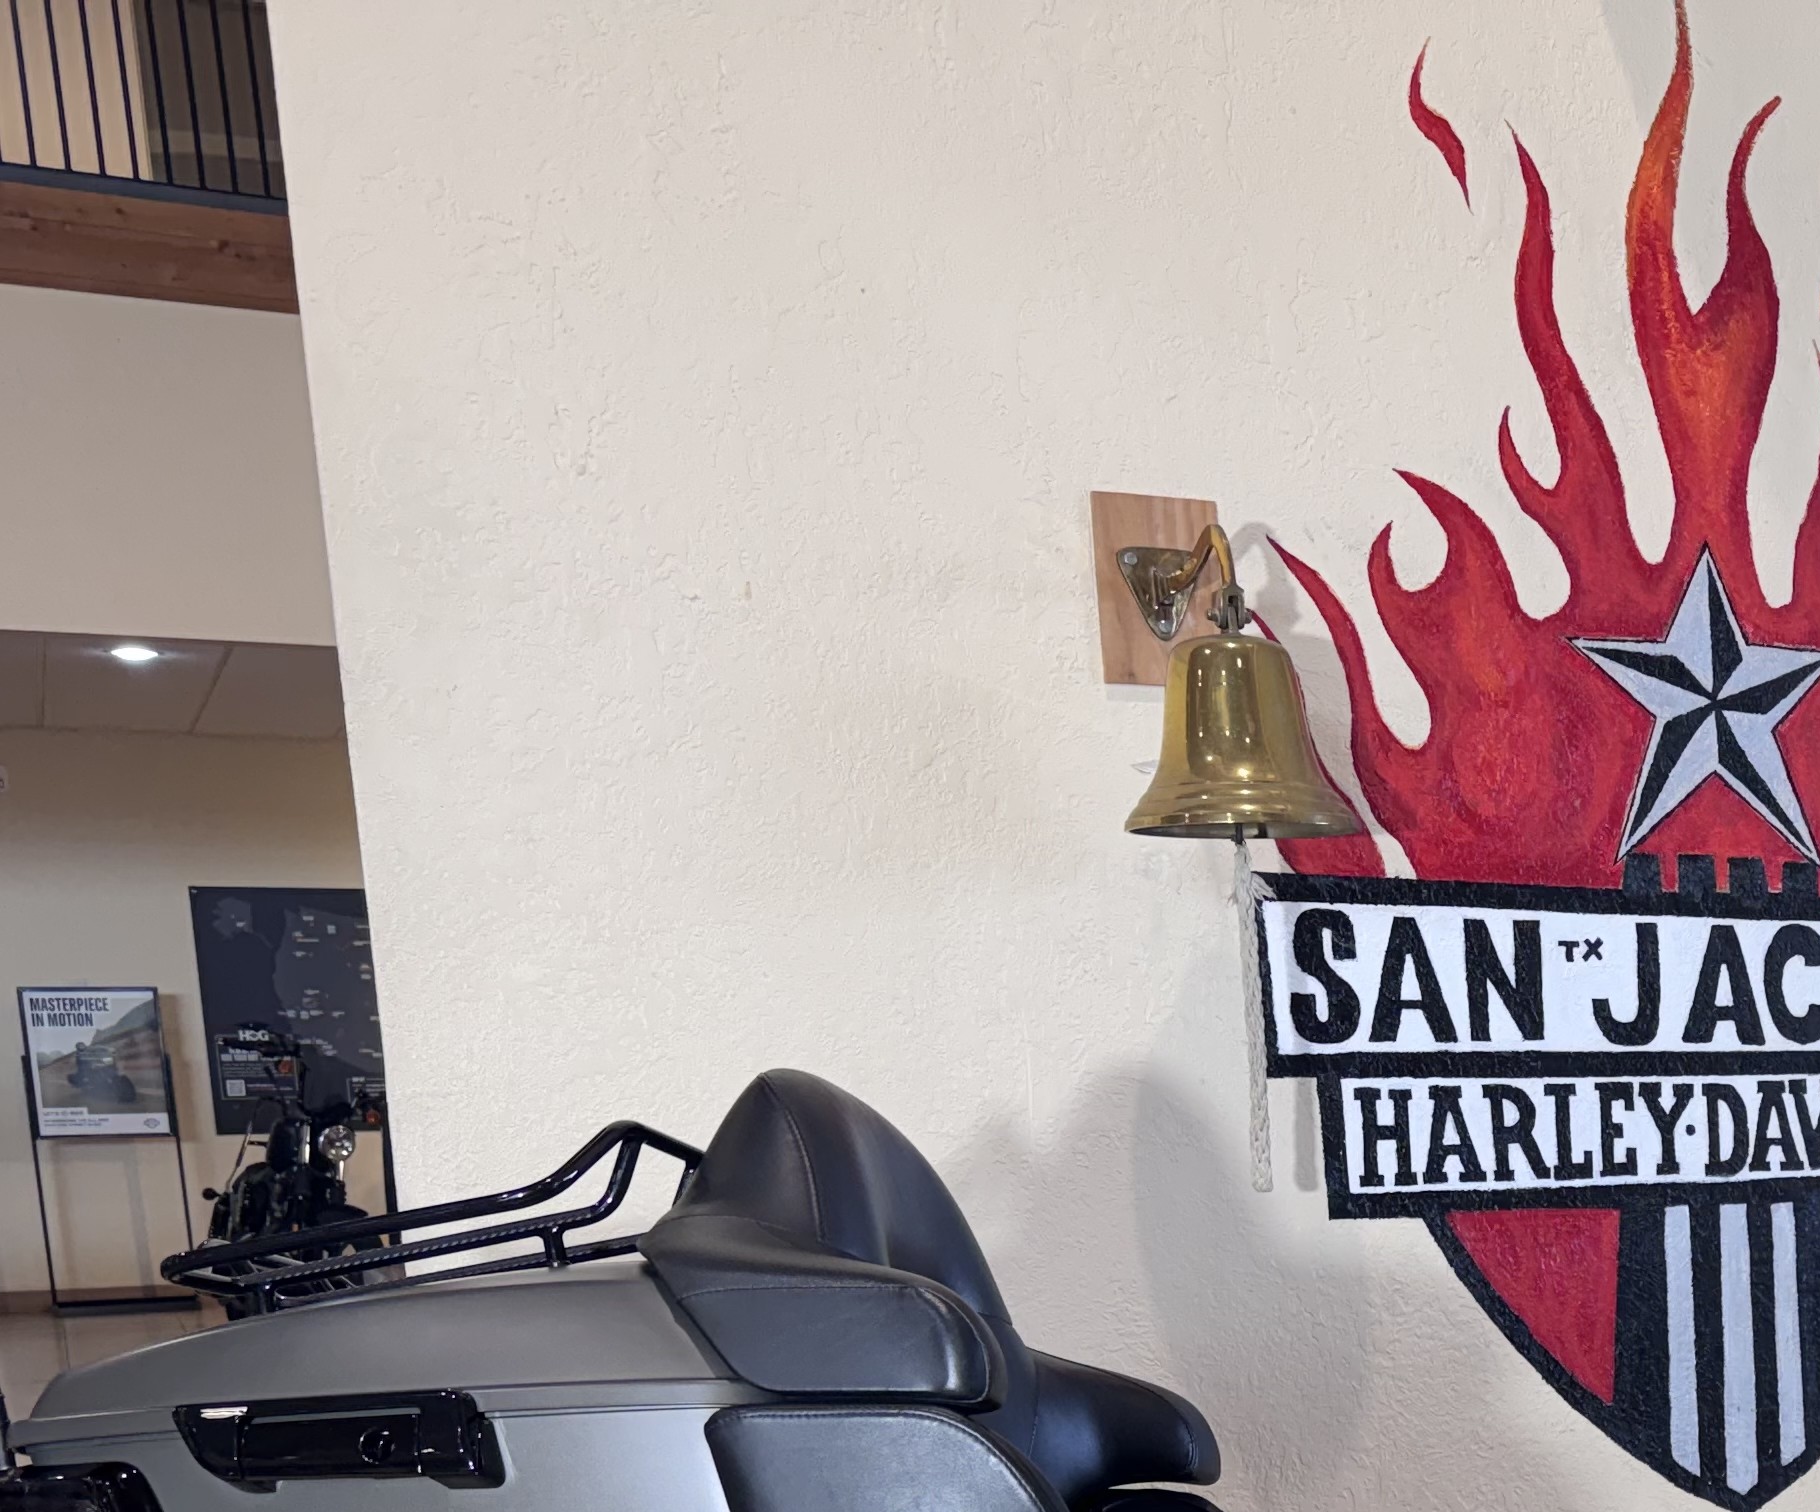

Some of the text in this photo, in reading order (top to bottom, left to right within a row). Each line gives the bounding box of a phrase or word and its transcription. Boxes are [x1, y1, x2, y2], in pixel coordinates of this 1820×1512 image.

[1290, 907, 1545, 1046] SAN
[1559, 937, 1604, 963] TX
[29, 997, 109, 1012] MASTERPIECE
[31, 1012, 94, 1027] IN MOTION
